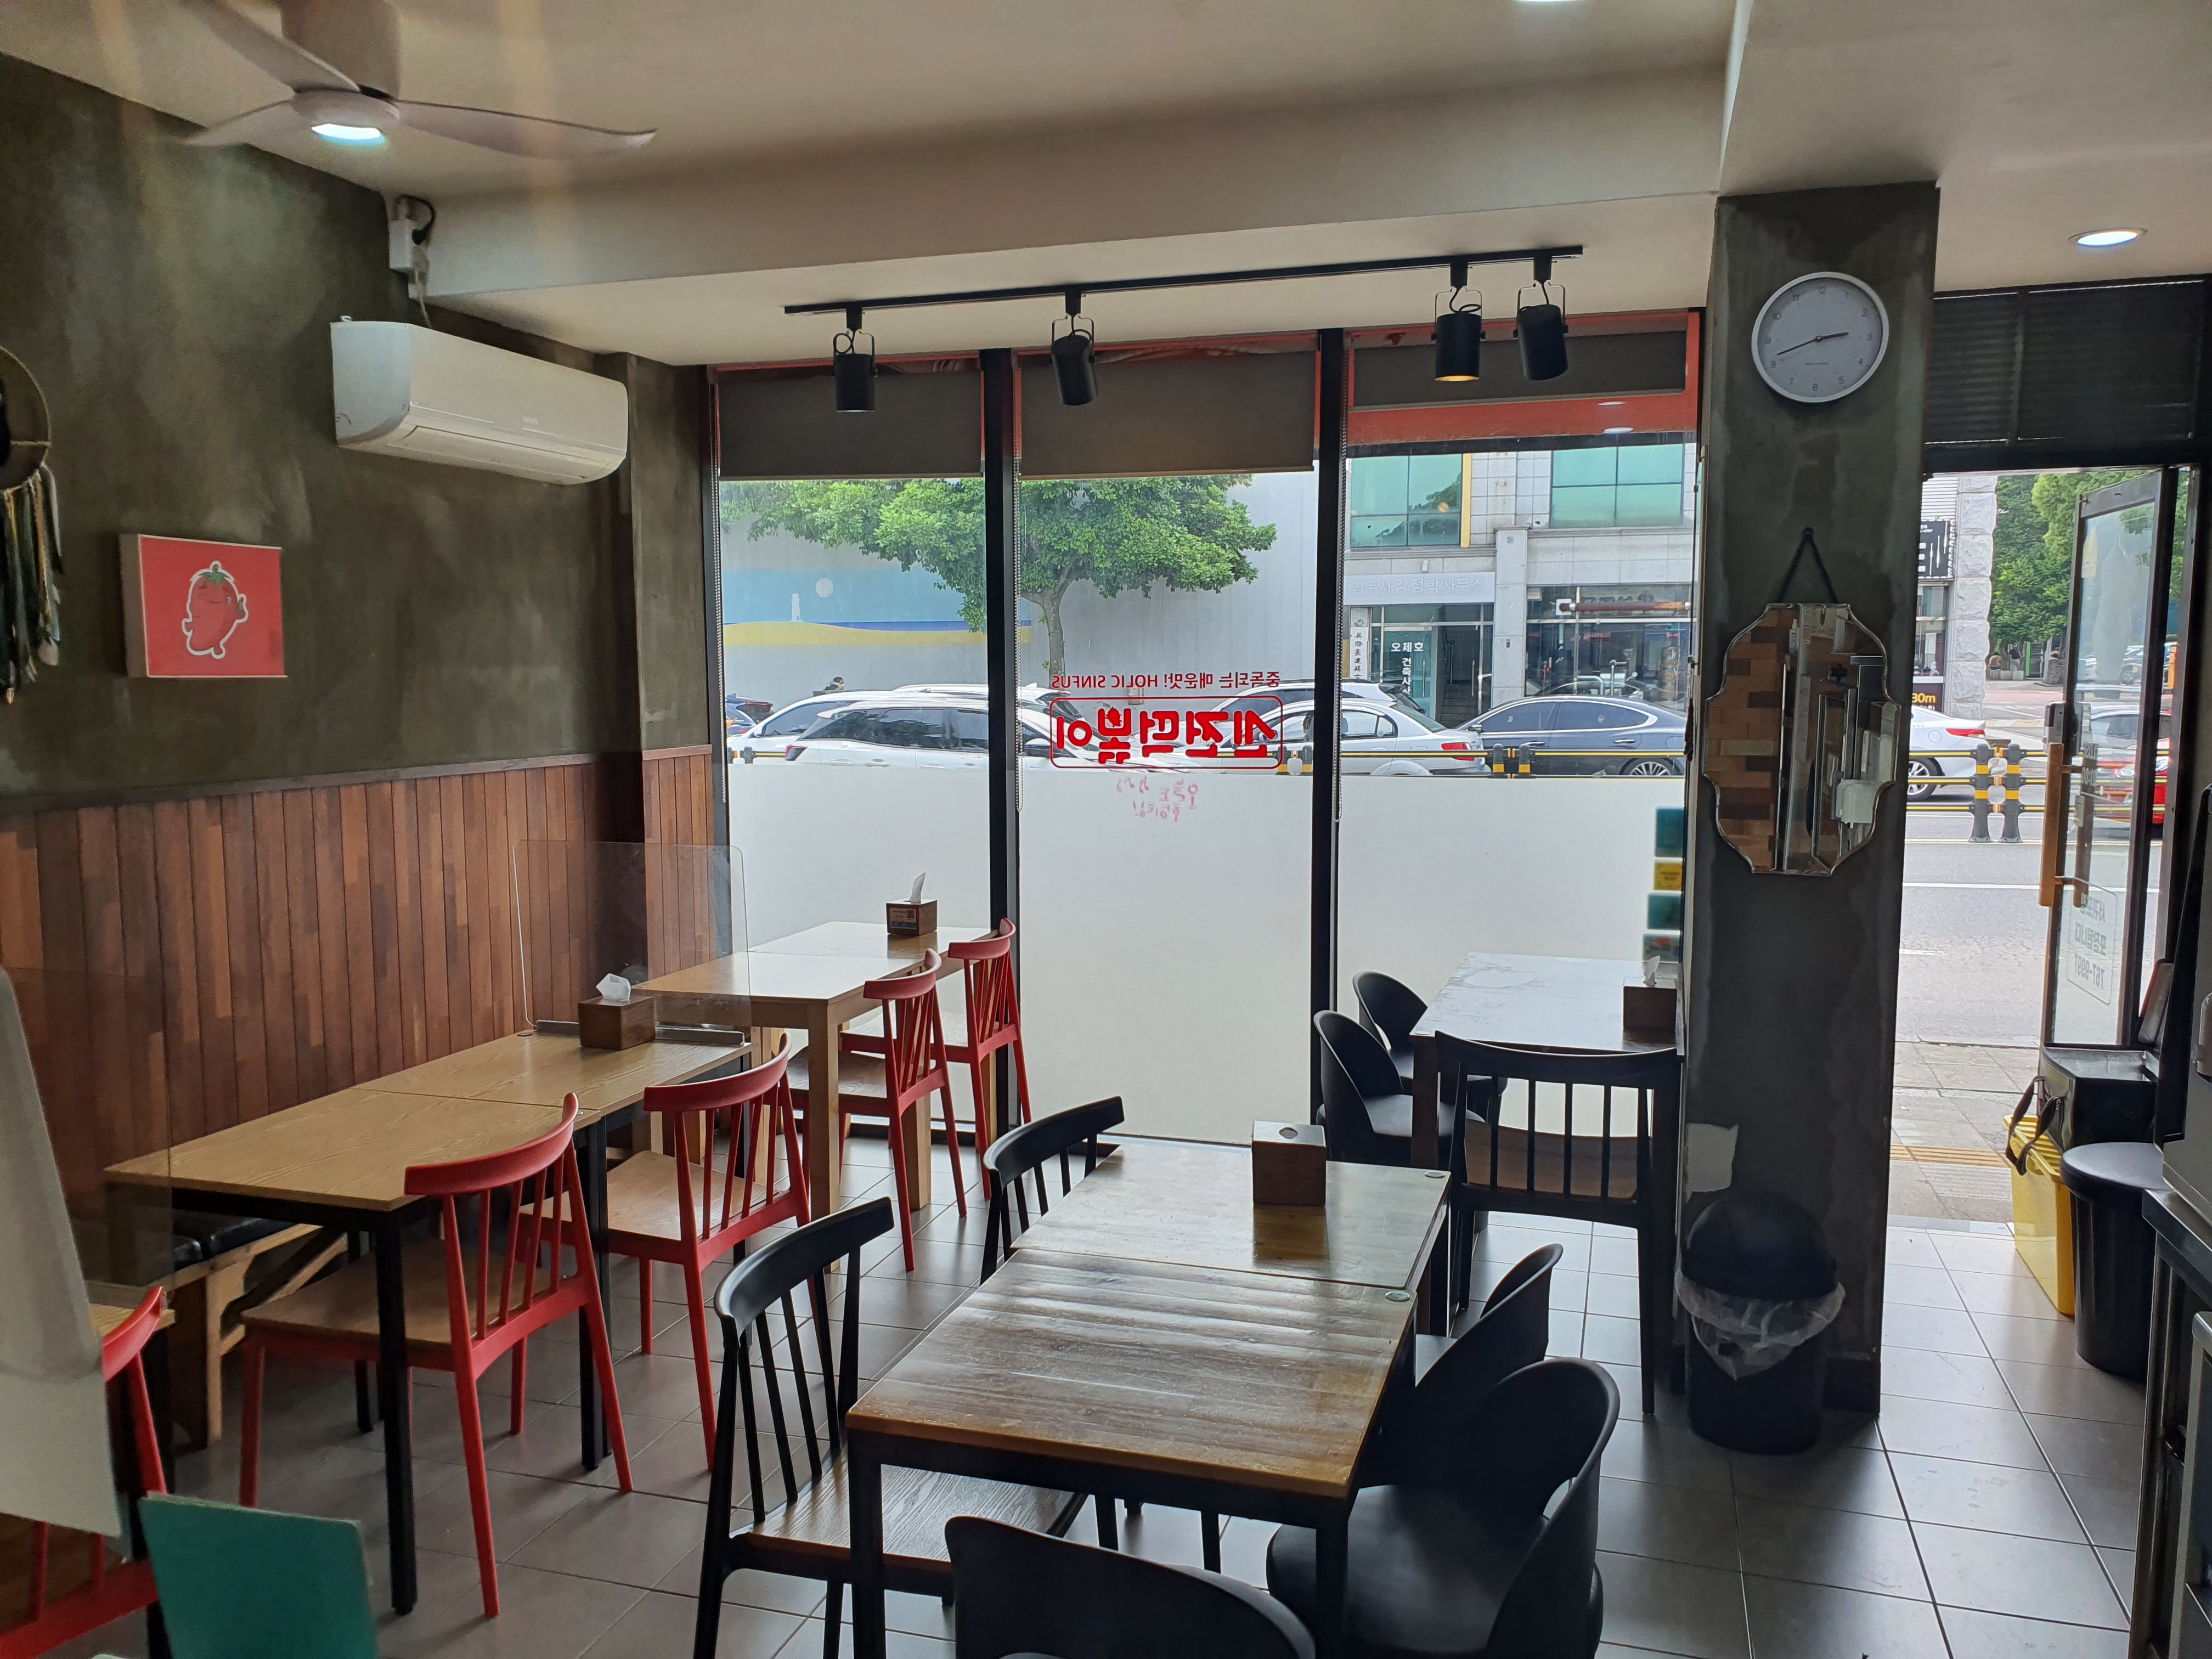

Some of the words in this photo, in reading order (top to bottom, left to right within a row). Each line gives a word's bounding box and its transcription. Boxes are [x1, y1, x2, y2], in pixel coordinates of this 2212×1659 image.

[1862, 309, 1868, 317] 2
[1770, 360, 1776, 369] 8
[1391, 642, 1424, 652] 오제호
